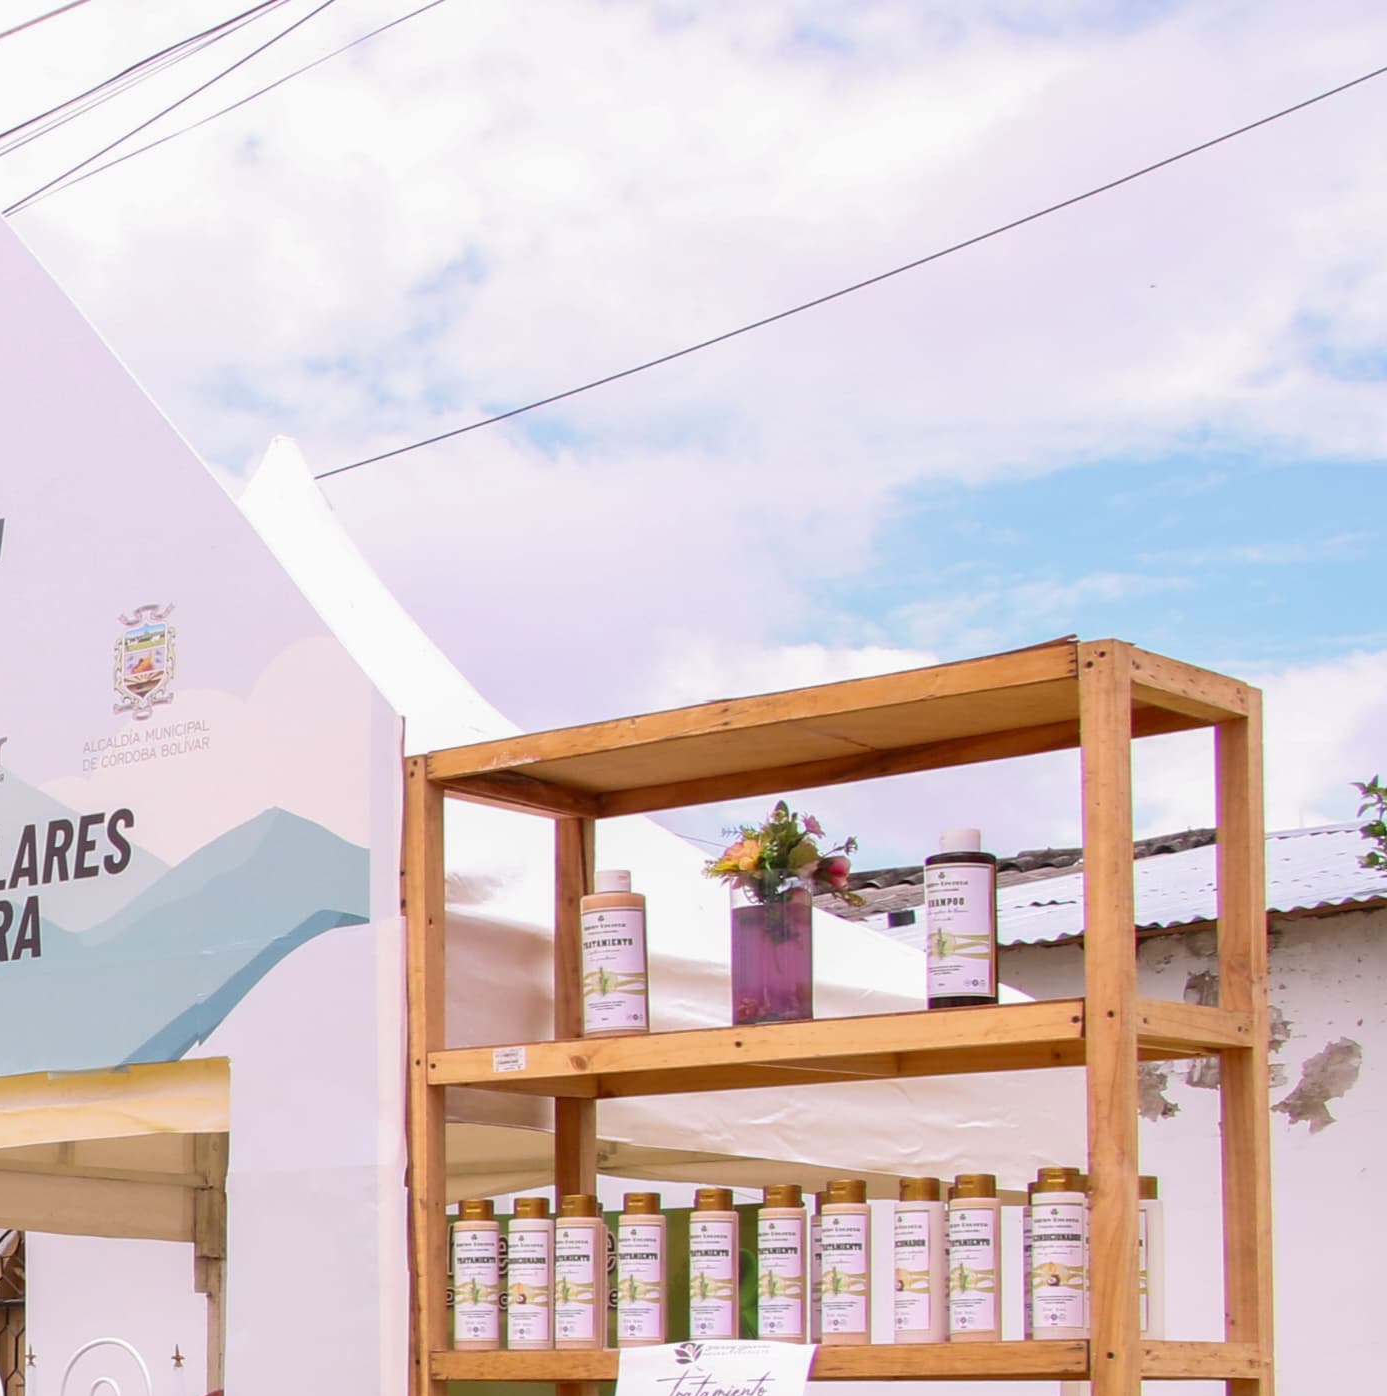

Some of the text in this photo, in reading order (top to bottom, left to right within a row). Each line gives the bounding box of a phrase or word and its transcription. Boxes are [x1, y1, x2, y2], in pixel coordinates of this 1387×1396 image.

[82, 735, 210, 772] DE CÓRDOBA BOLÍVAR
[83, 720, 210, 754] ALCALDÍA MUNICIPAL
